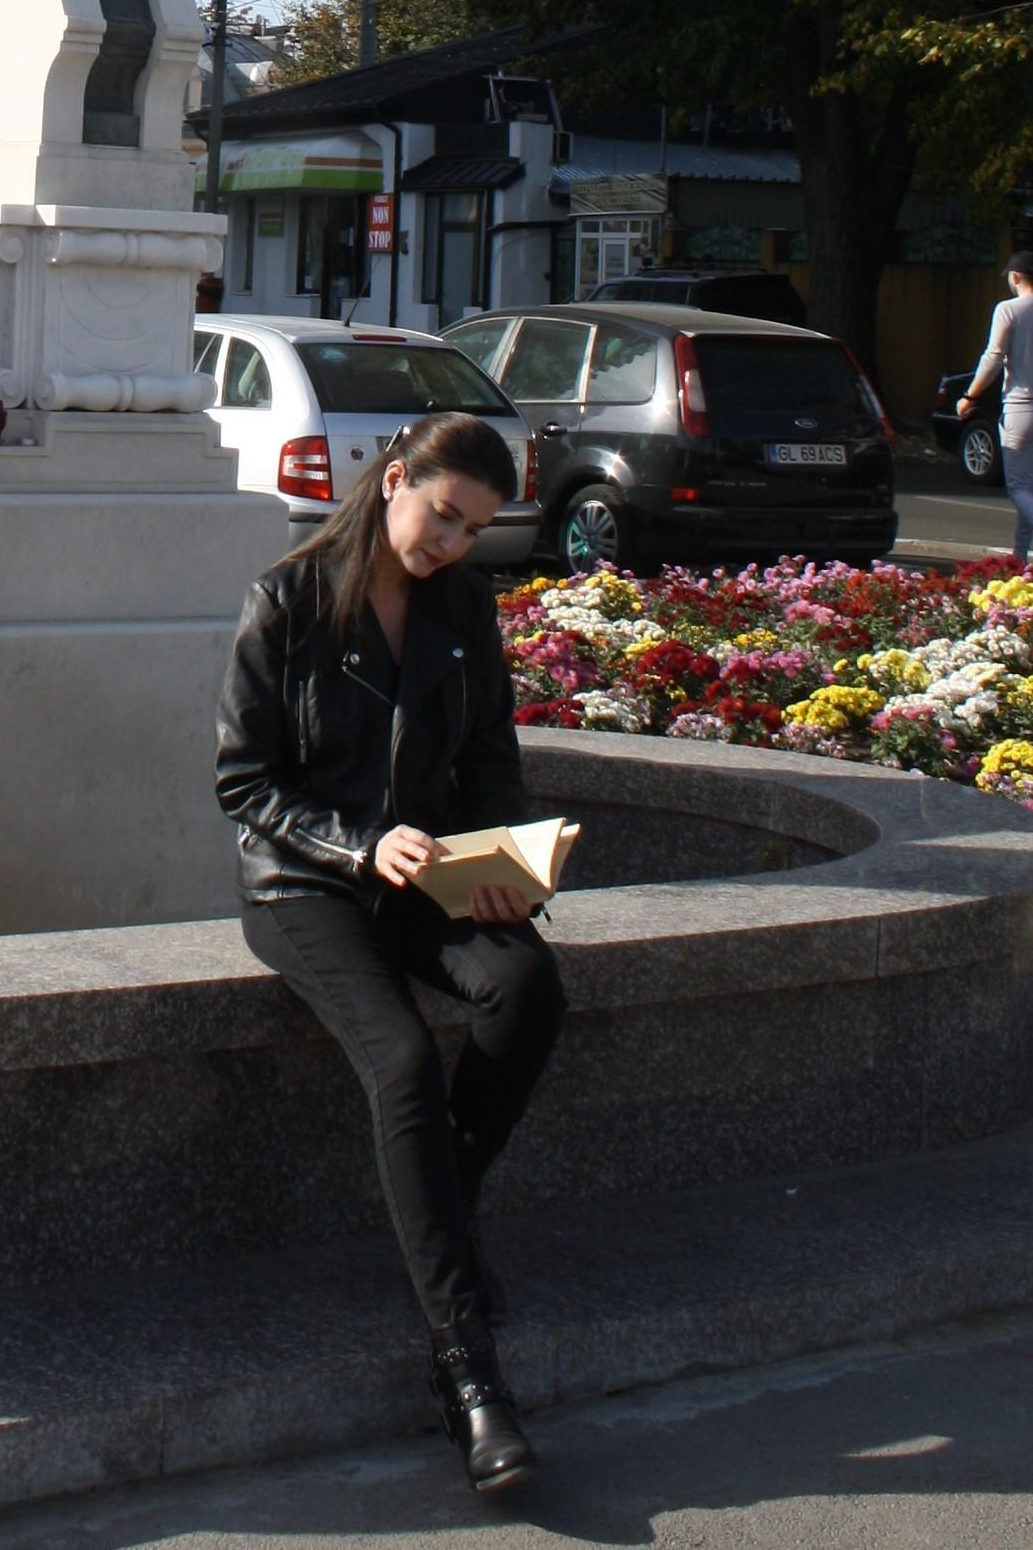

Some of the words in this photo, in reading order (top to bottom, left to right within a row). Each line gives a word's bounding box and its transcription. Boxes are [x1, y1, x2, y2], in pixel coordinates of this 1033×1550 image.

[372, 206, 390, 224] NON
[368, 231, 391, 248] STOP
[777, 445, 796, 461] GL
[800, 446, 816, 461] 69
[818, 447, 843, 462] ACS
